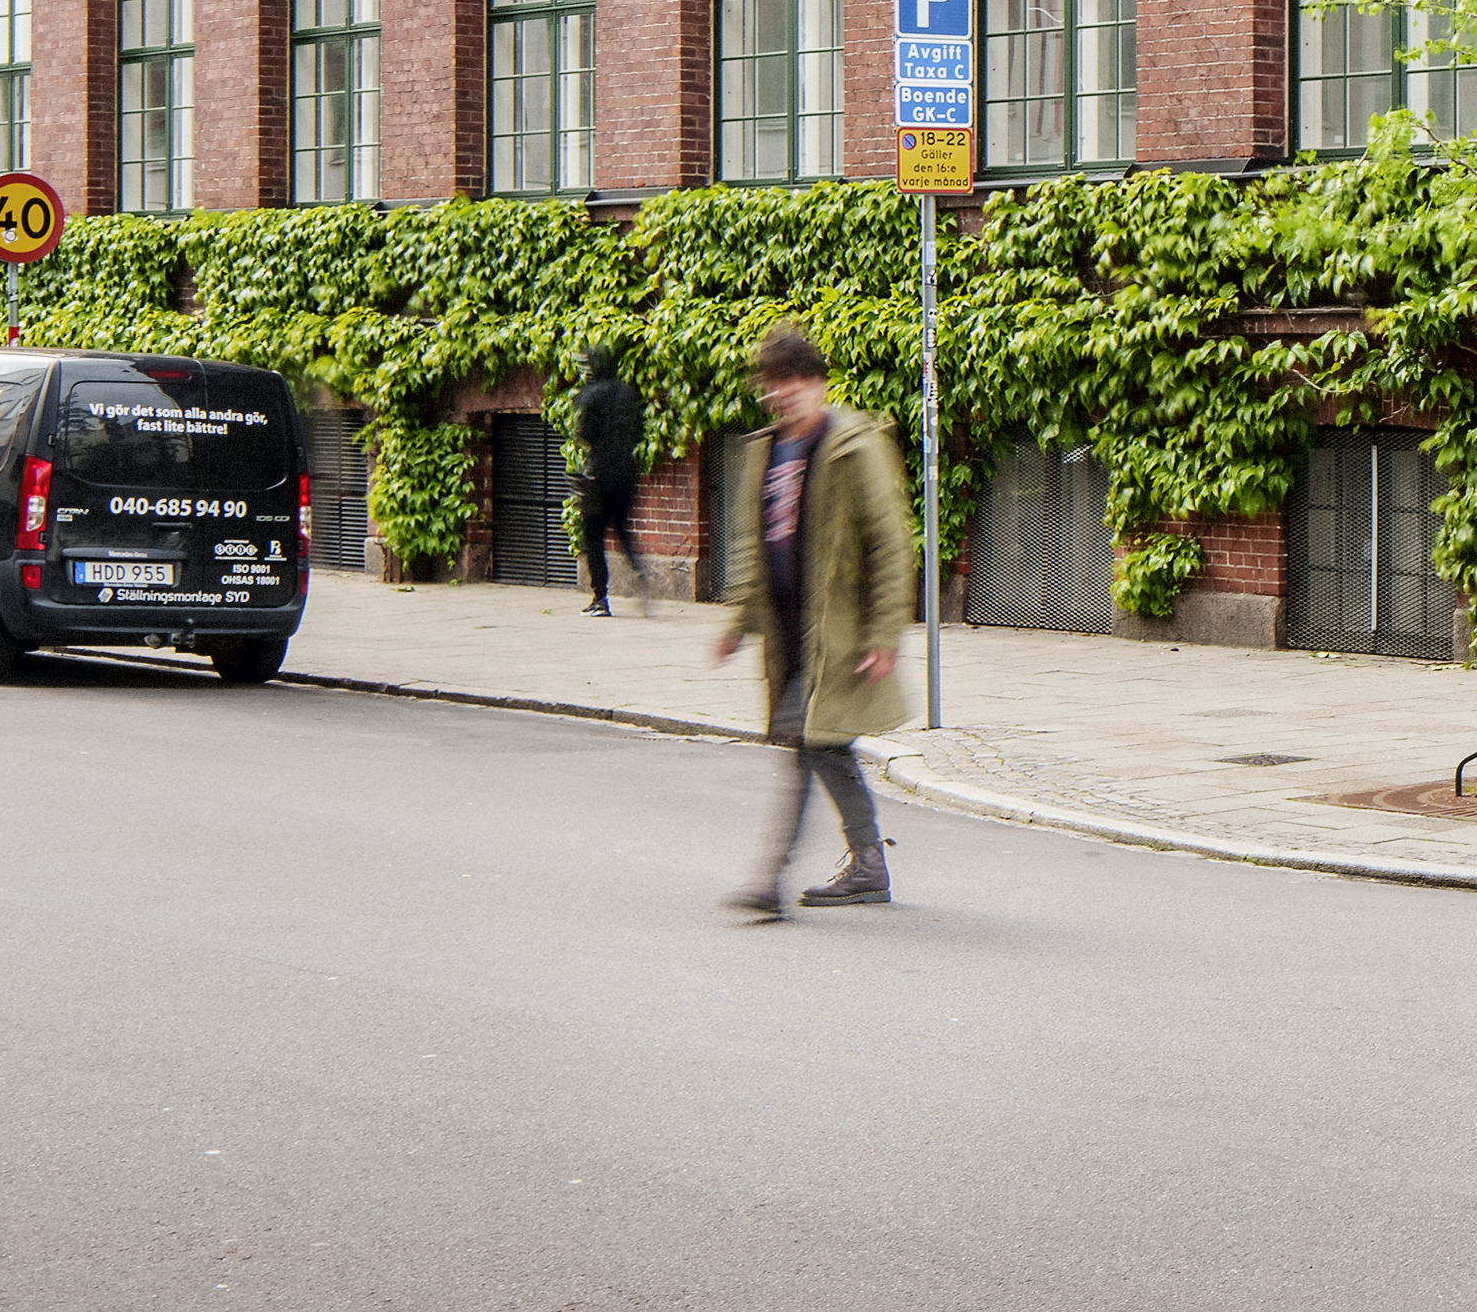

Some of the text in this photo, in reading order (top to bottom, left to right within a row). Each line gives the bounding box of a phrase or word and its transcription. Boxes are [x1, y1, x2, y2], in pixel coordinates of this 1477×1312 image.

[907, 43, 962, 63] Avgift
[904, 62, 964, 79] Taxa C
[901, 87, 967, 104] Boende
[912, 106, 956, 123] GK-C
[920, 131, 966, 146] 18-22
[921, 149, 953, 159] Gäller
[913, 163, 957, 173] den 16:e
[902, 176, 969, 188] varje månad
[88, 403, 268, 425] Vi gör det som alla andra gör,
[137, 419, 228, 434] fast lite bättre!
[109, 496, 248, 518] 040-685 94 90
[92, 564, 166, 582] HDD 955
[232, 564, 271, 574] ISO 9001
[221, 575, 280, 585] OHSAS 18001
[116, 588, 250, 606] Ställningsmontage SYD
